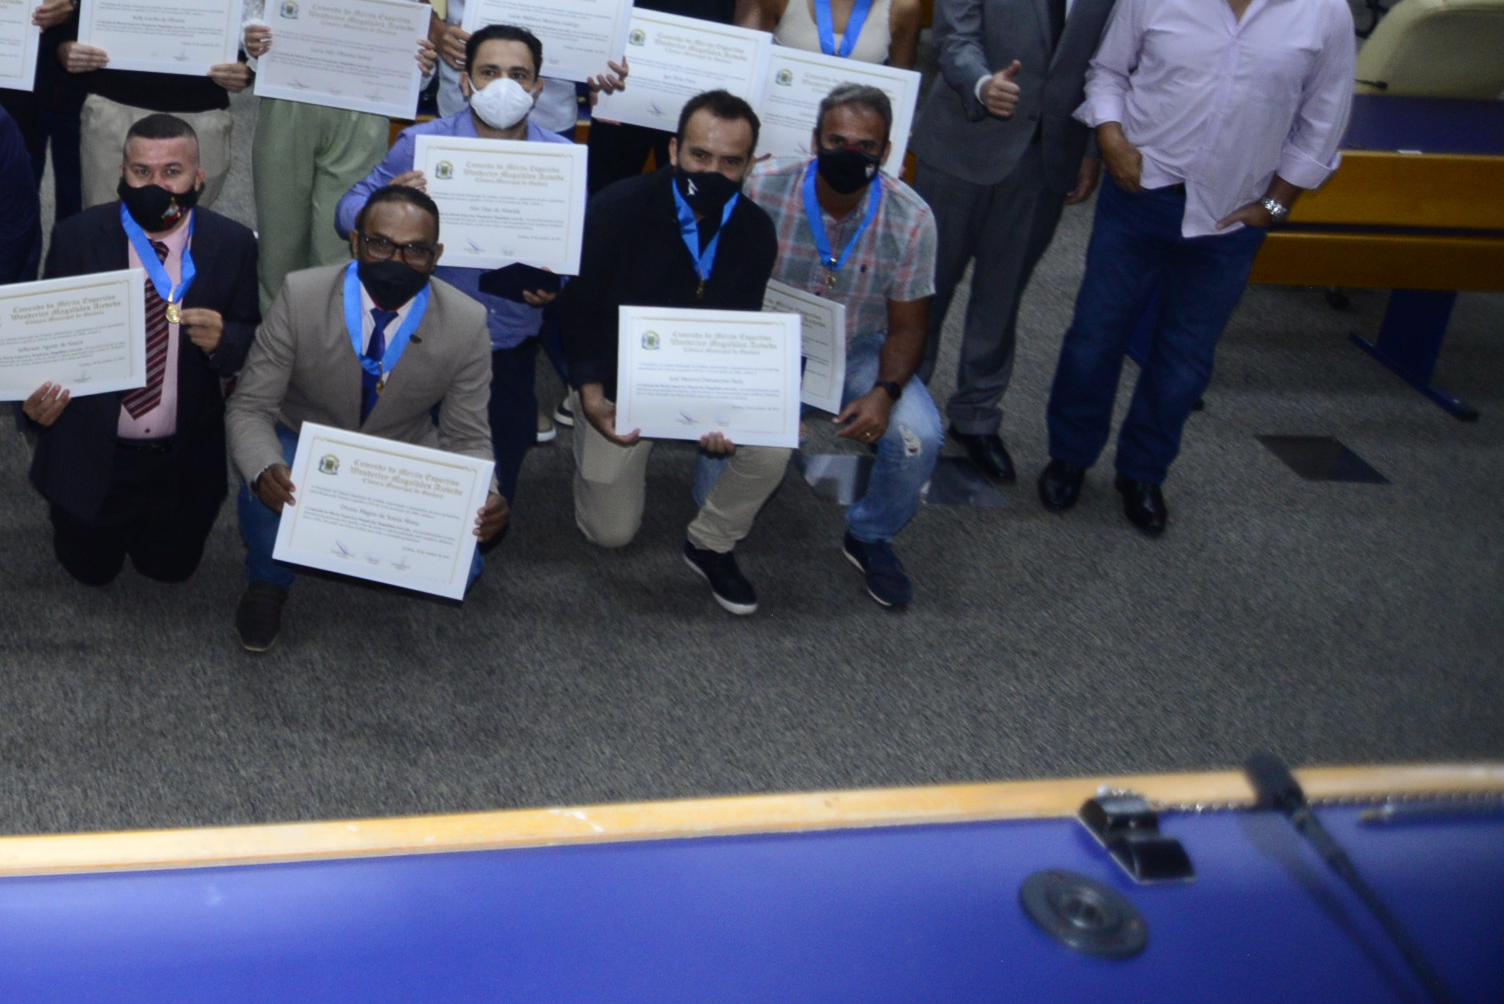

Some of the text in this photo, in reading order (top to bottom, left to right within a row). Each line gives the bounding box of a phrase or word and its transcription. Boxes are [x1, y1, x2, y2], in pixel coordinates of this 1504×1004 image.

[11, 310, 49, 320] Wanderley
[93, 301, 121, 310] Azevedo
[12, 304, 43, 312] Comenda
[82, 295, 116, 304] Esportivo
[351, 467, 389, 481] Wanderley
[434, 484, 463, 495] Azevedo
[354, 460, 386, 472] Comenda
[425, 474, 459, 487] Esportivo
